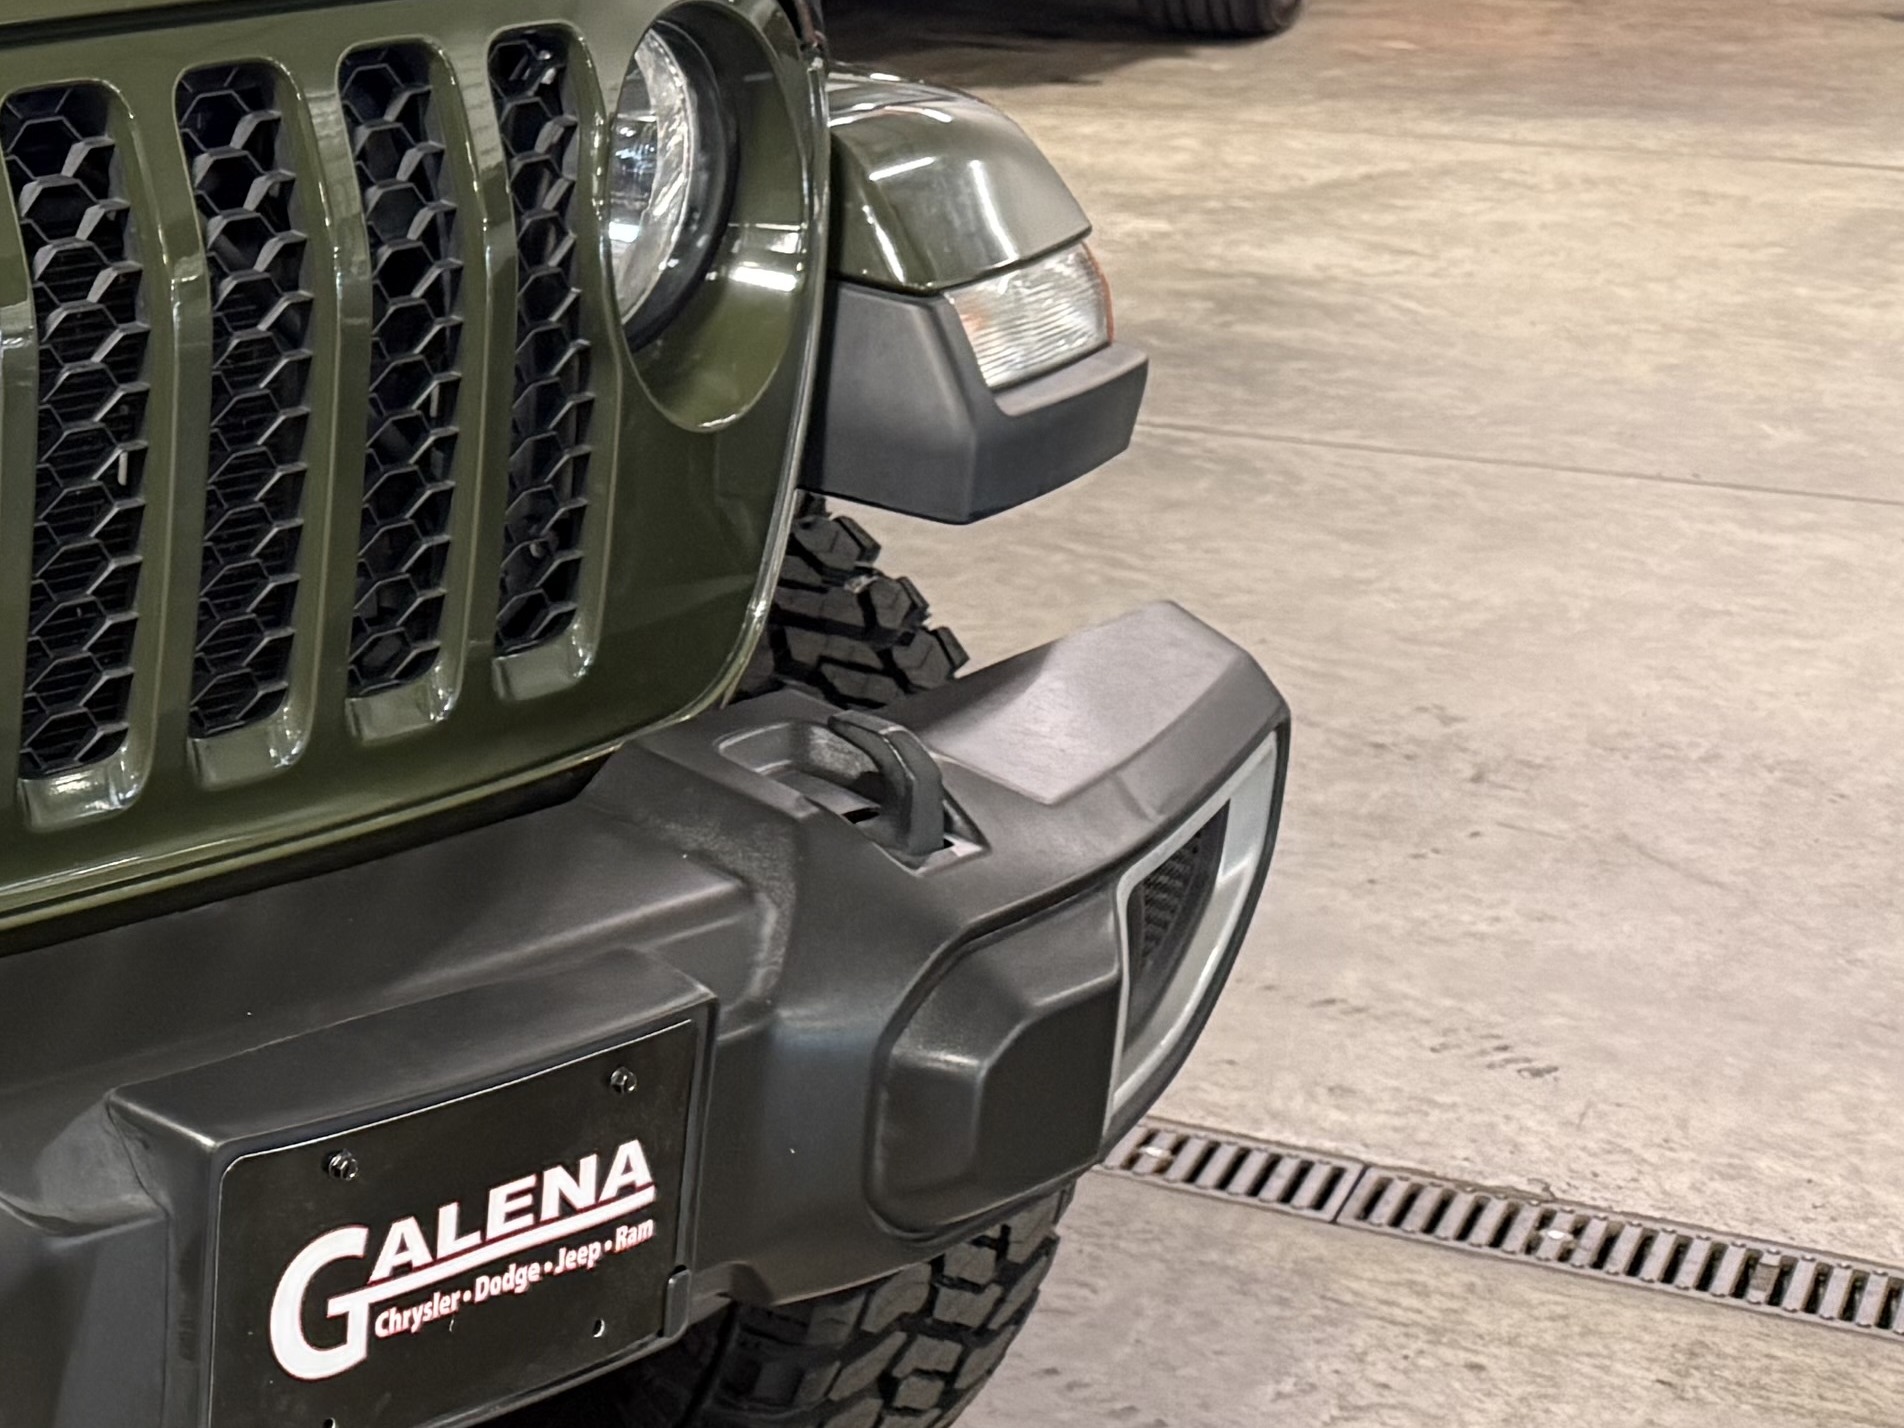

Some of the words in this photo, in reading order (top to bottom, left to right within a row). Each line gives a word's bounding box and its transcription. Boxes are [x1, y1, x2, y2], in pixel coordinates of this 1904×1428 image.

[269, 1138, 656, 1380] GALENA
[374, 1290, 462, 1339] Chrysler
[474, 1262, 542, 1303] Dodge
[553, 1241, 602, 1274] Jeep
[614, 1218, 654, 1253] Ram
